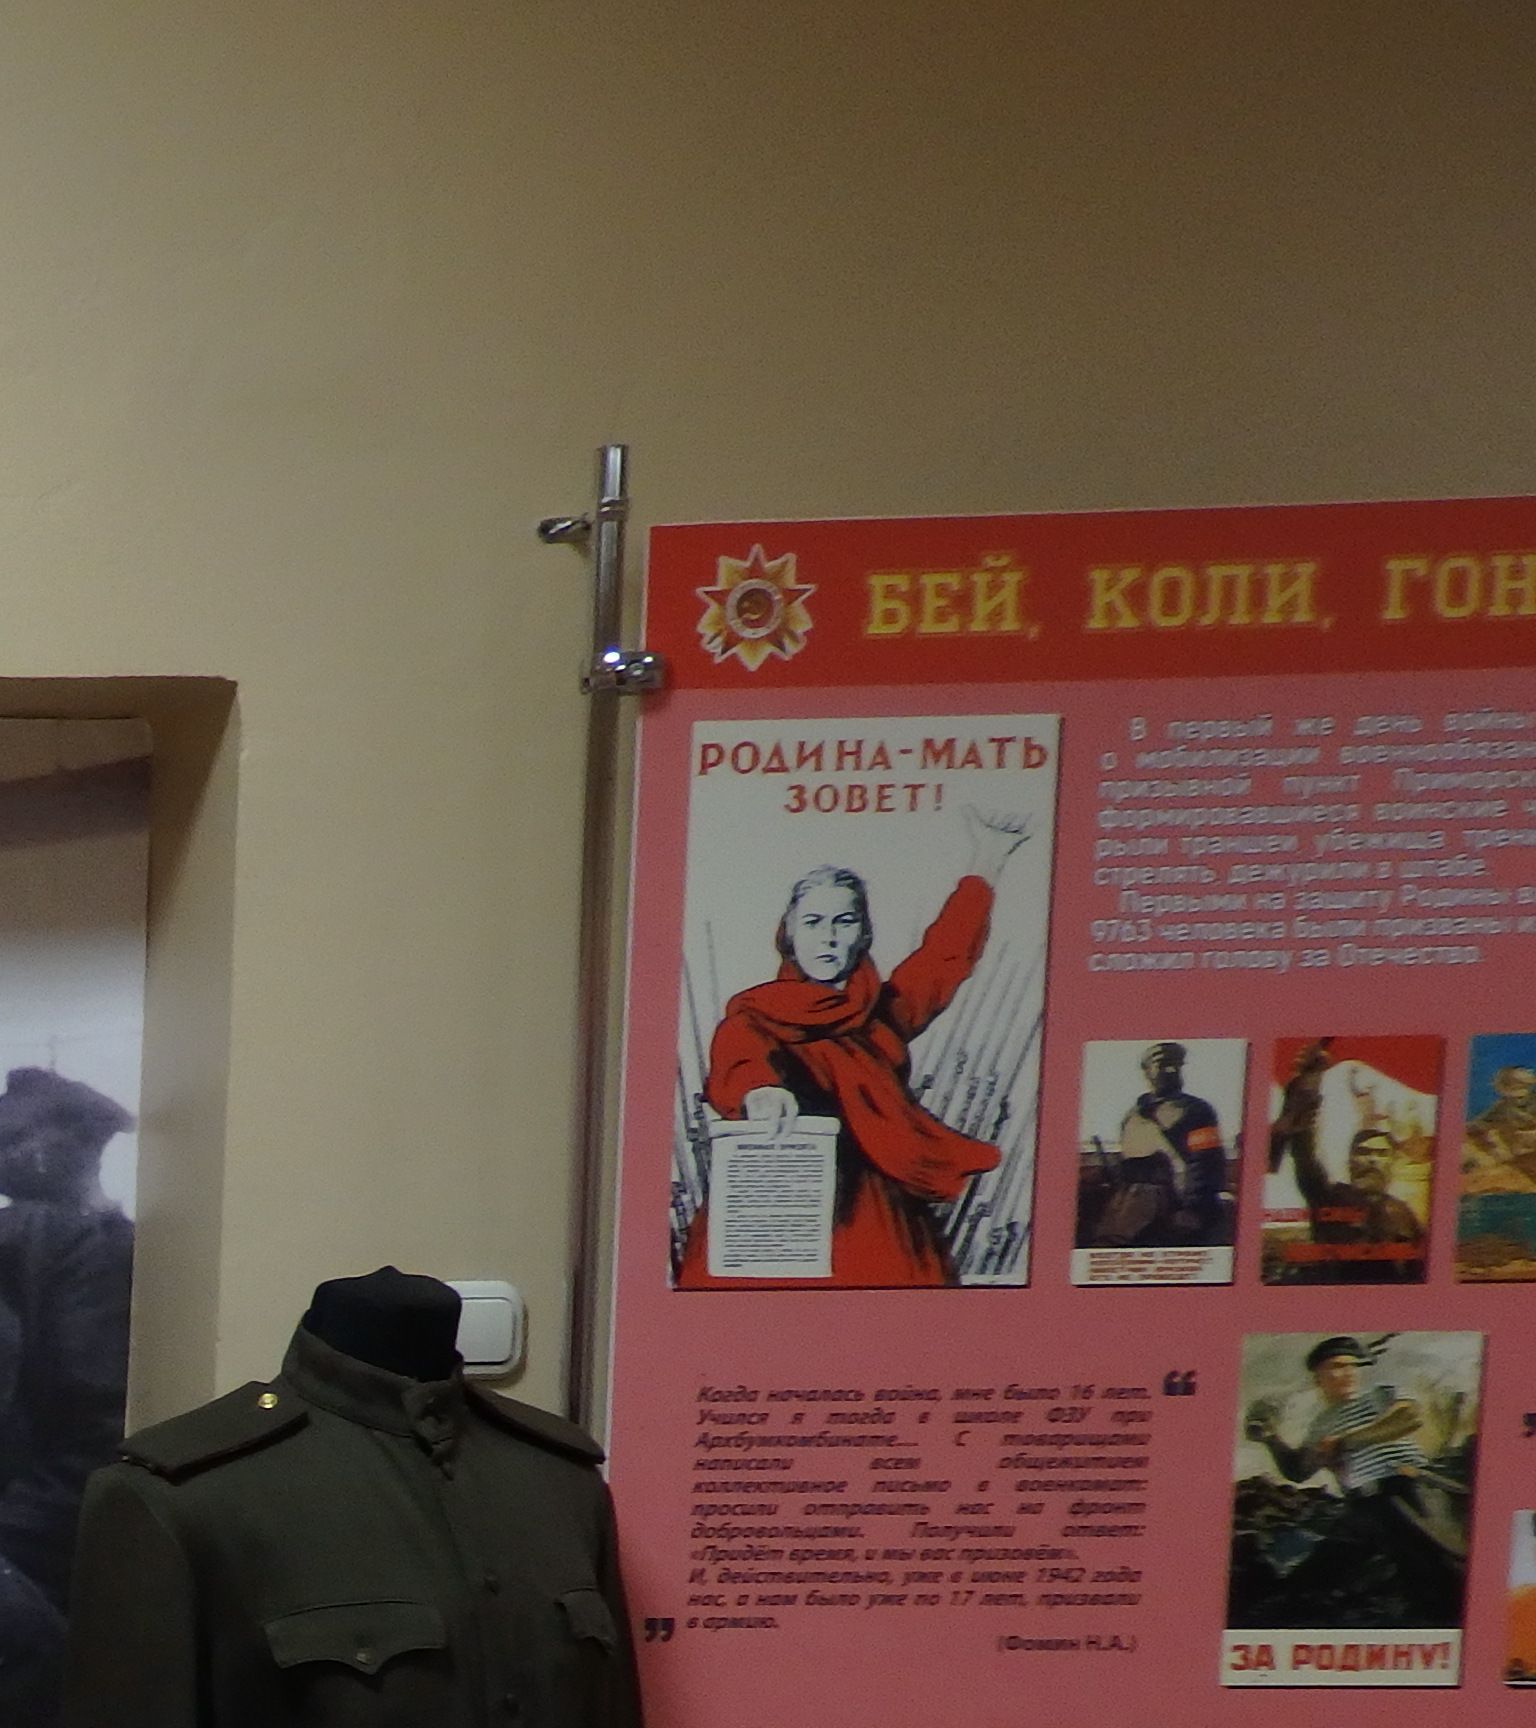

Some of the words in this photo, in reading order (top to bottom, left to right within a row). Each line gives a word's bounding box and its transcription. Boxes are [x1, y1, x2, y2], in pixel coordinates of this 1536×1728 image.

[862, 553, 1042, 641] БЕЙ,
[1083, 564, 1335, 640] КОЛИ,
[699, 736, 1048, 776] РОДИНА-МАТЬ
[784, 783, 944, 814] ЗОВЕТ!
[1231, 1644, 1276, 1671] ЗА
[1292, 1642, 1450, 1671] РОДИНУ!
